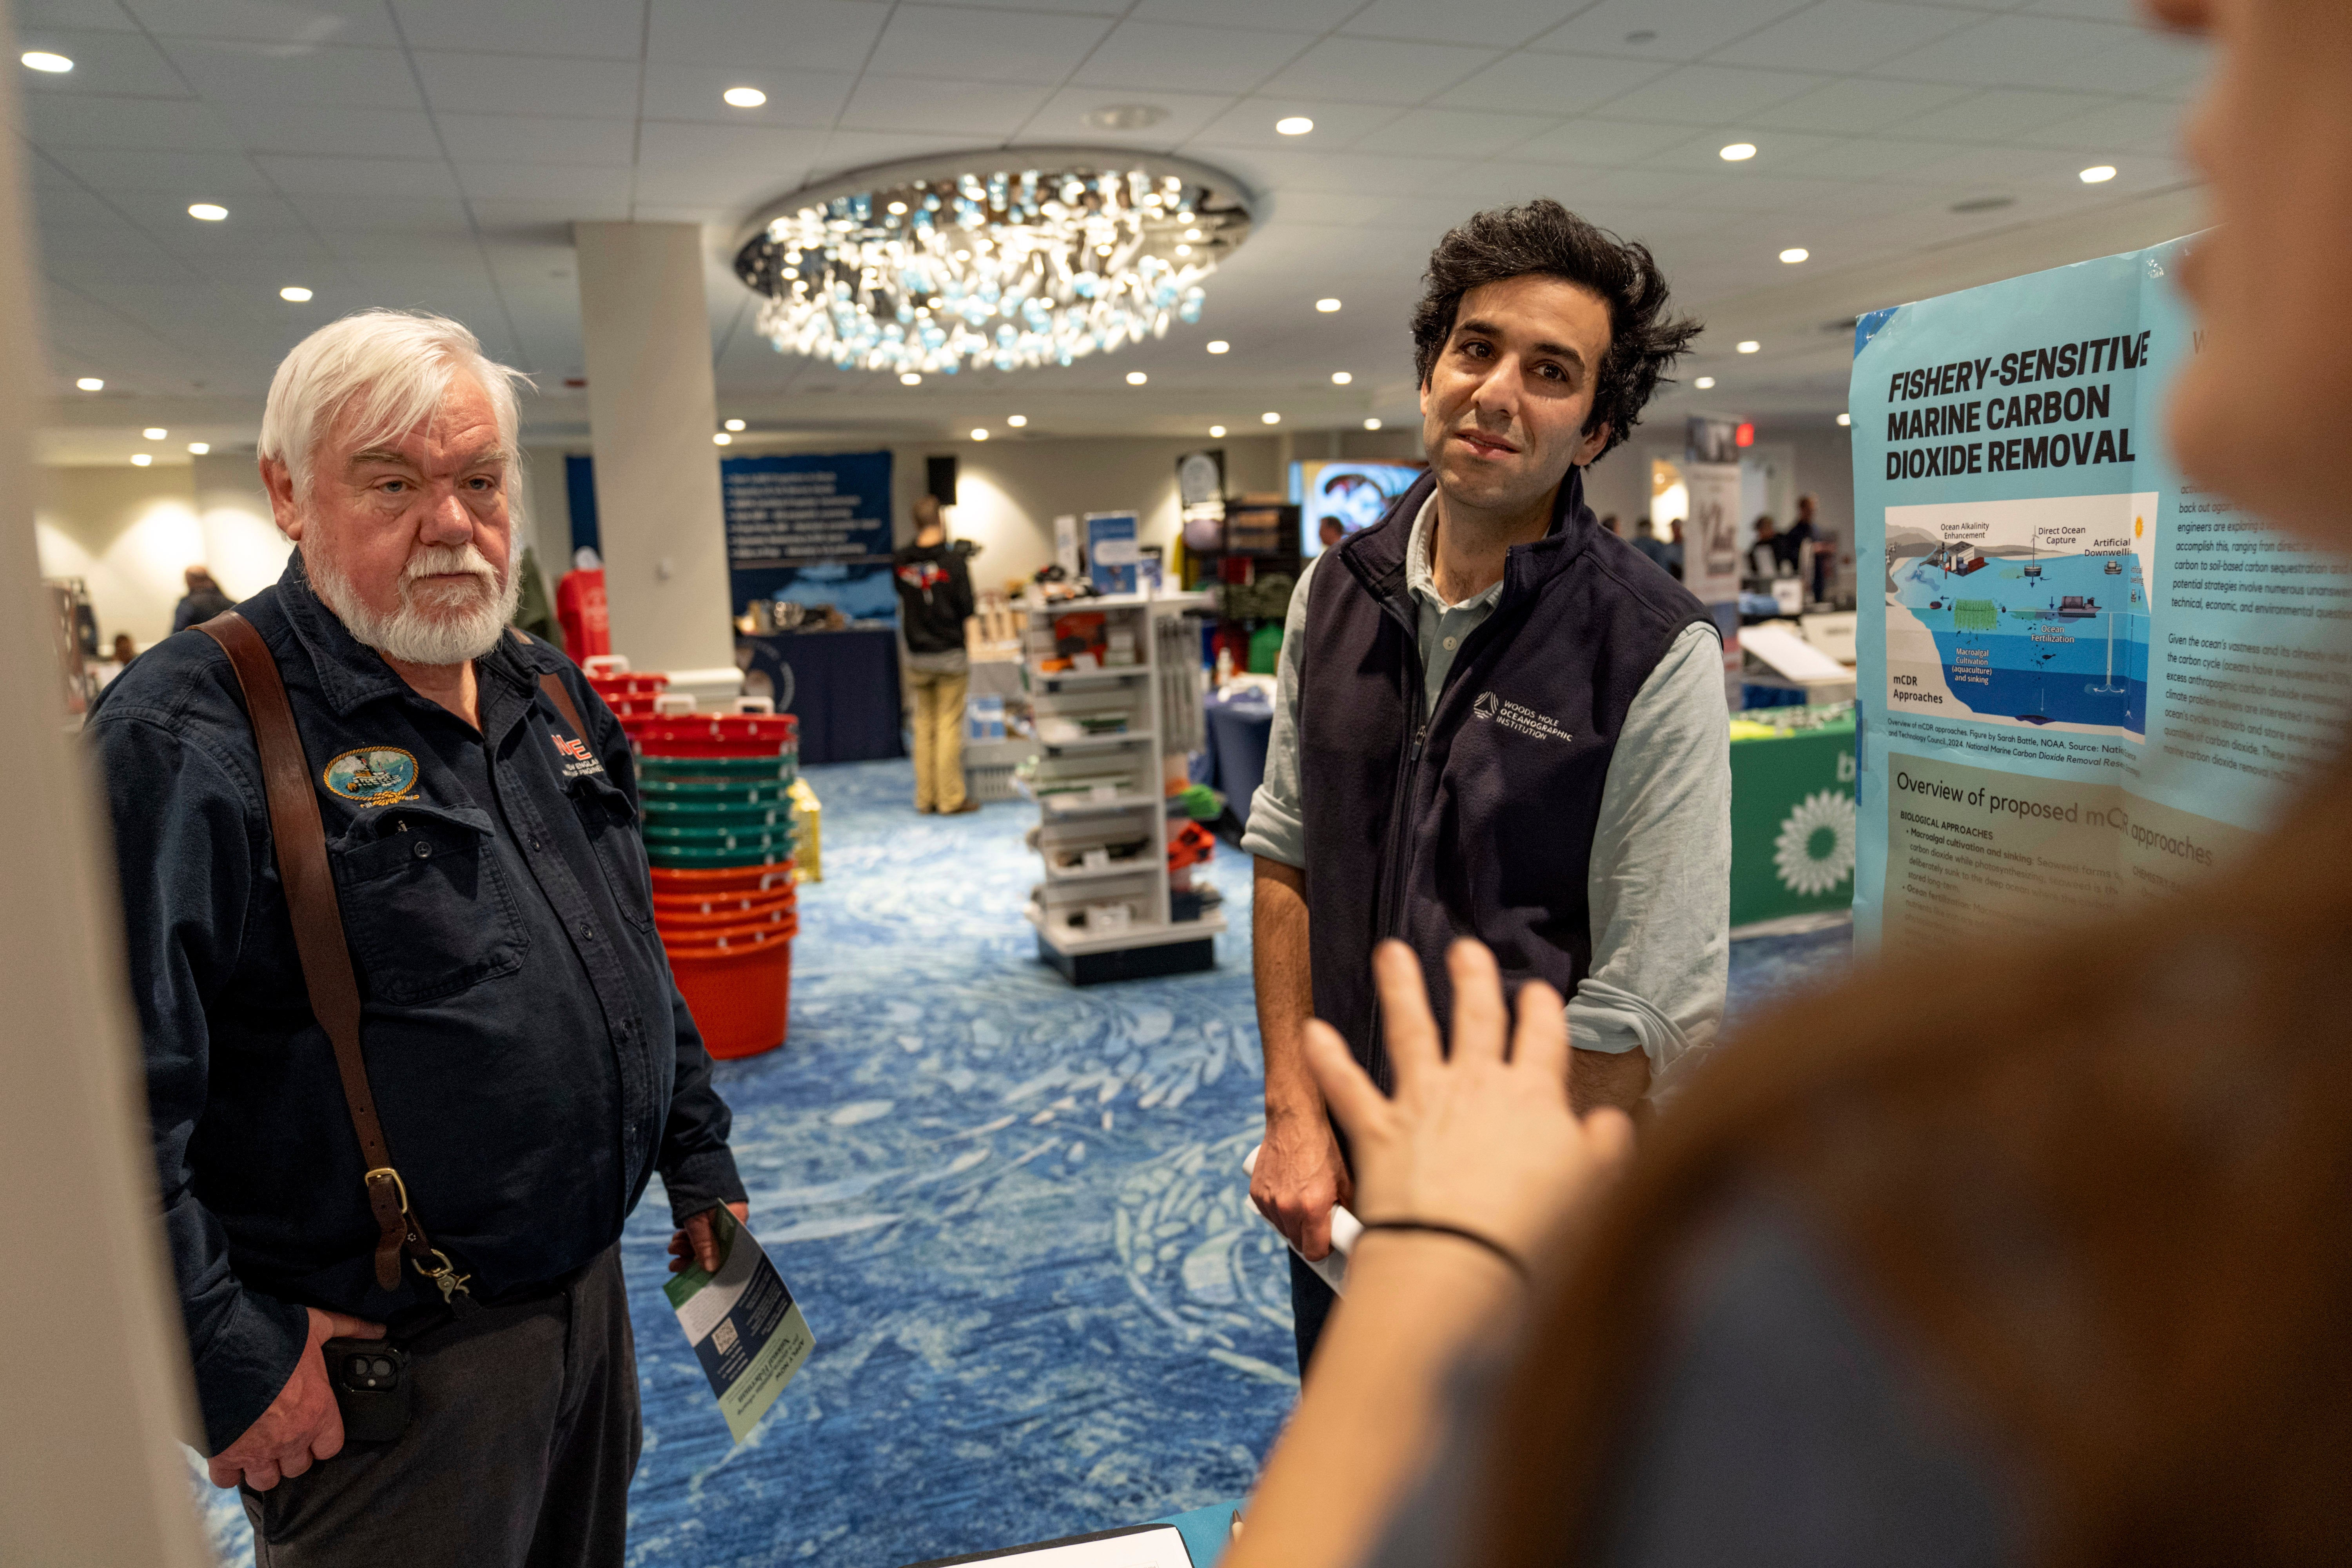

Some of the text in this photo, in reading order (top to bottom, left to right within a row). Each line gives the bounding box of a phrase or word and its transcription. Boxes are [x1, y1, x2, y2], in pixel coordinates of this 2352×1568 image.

[1888, 330, 2151, 403] FISHERY-SENSITIVE
[1887, 384, 2110, 441] MARINE CARBON
[1886, 428, 2136, 480] DIOXIDE REMOVAL
[2179, 502, 2196, 513] back
[2198, 503, 2210, 512] out
[1944, 531, 1985, 539] Enhancement
[1960, 522, 1989, 532] Alkalinity
[2038, 526, 2086, 535] Direct Ocean
[2178, 521, 2212, 534] engineers
[2214, 523, 2225, 532] are
[2046, 536, 2076, 544] Capture
[2093, 538, 2131, 547] Artificial
[2176, 540, 2214, 553] accomplish
[2216, 540, 2229, 552] this,
[2232, 542, 2257, 554] ranging
[2259, 540, 2275, 552] from
[2174, 559, 2198, 570] carbon
[2201, 561, 2208, 570] to
[2209, 559, 2243, 572] soil-based
[2245, 561, 2268, 573] carbon
[2270, 563, 2327, 575] sequestration
[2173, 579, 2203, 590] potential
[2204, 580, 2237, 593] strategies
[2239, 580, 2263, 593] involve
[2265, 584, 2305, 596] numerous
[2172, 597, 2203, 610] technical,
[2205, 601, 2237, 613] economic,
[2239, 601, 2254, 613] and
[2255, 603, 2314, 617] environmental
[2041, 625, 2065, 633] Ocean
[2031, 633, 2074, 643] Fertilization
[2169, 633, 2187, 645] Given
[2189, 635, 2199, 646] the
[2229, 643, 2260, 654] vastness
[1956, 648, 1989, 658] Macroalgal
[1956, 657, 1988, 666] Cultivation
[1952, 665, 1992, 676] (aquaculture)
[2167, 651, 2177, 662] the
[2179, 653, 2201, 666] carbon
[2203, 657, 2220, 670] cycle
[2222, 659, 2250, 673] (oceans
[1893, 675, 1918, 686] mCDR
[1955, 674, 1989, 685] and sinking
[2166, 672, 2187, 683] excess
[2188, 675, 2237, 692] anthropogenic
[1893, 688, 1943, 704] Approaches
[2165, 688, 2187, 702] climate
[1504, 700, 1559, 726] WOODS HOLE
[1496, 715, 1547, 740] INSTITUTION
[1500, 708, 1573, 742] OCEANOGRAPHIC
[2221, 718, 2245, 733] absorb
[2247, 724, 2262, 736] and
[1887, 718, 1911, 728] Overview
[1918, 723, 1934, 731] mCDR
[1935, 727, 1968, 737] approaches.
[1970, 730, 1987, 739] Figure
[1989, 731, 1996, 741] by
[1997, 733, 2015, 743] Sarah
[2017, 736, 2039, 747] Battle,
[2041, 739, 2066, 749] NOAA.
[2069, 742, 2099, 752] Source:
[1898, 731, 1926, 743] Technology
[1966, 742, 1989, 751] National
[1991, 744, 2011, 755] Marine
[2013, 748, 2036, 758] Carbon
[2039, 751, 2064, 762] Dioxide
[2067, 755, 2101, 766] Removal
[2205, 735, 2230, 749] carbon
[2231, 739, 2259, 755] dioxide.
[1837, 750, 1856, 783] b
[2185, 750, 2210, 763] carbon
[2212, 753, 2237, 770] dioxide
[1897, 772, 2212, 867] Overview of proposed mCR approaches
[1901, 811, 1993, 840] BIOLOGICAL APPROACHES
[1910, 844, 1929, 855] carbon
[1931, 848, 1953, 861] dioxide
[1955, 855, 1973, 866] while
[1911, 828, 1945, 844] Macroalgal
[1946, 838, 1984, 853] cultivation
[1987, 848, 2001, 857] and
[2037, 856, 2078, 874] Seaweed
[2082, 864, 2111, 878] farms
[1908, 871, 1926, 882] stored
[1909, 855, 1943, 875] deliberately
[1945, 867, 1960, 878] sunk
[1962, 872, 1969, 880] to
[1971, 873, 1982, 883] the
[1985, 877, 2004, 889] deep
[2005, 883, 2029, 895] ocean
[1907, 884, 1927, 897] Ocean
